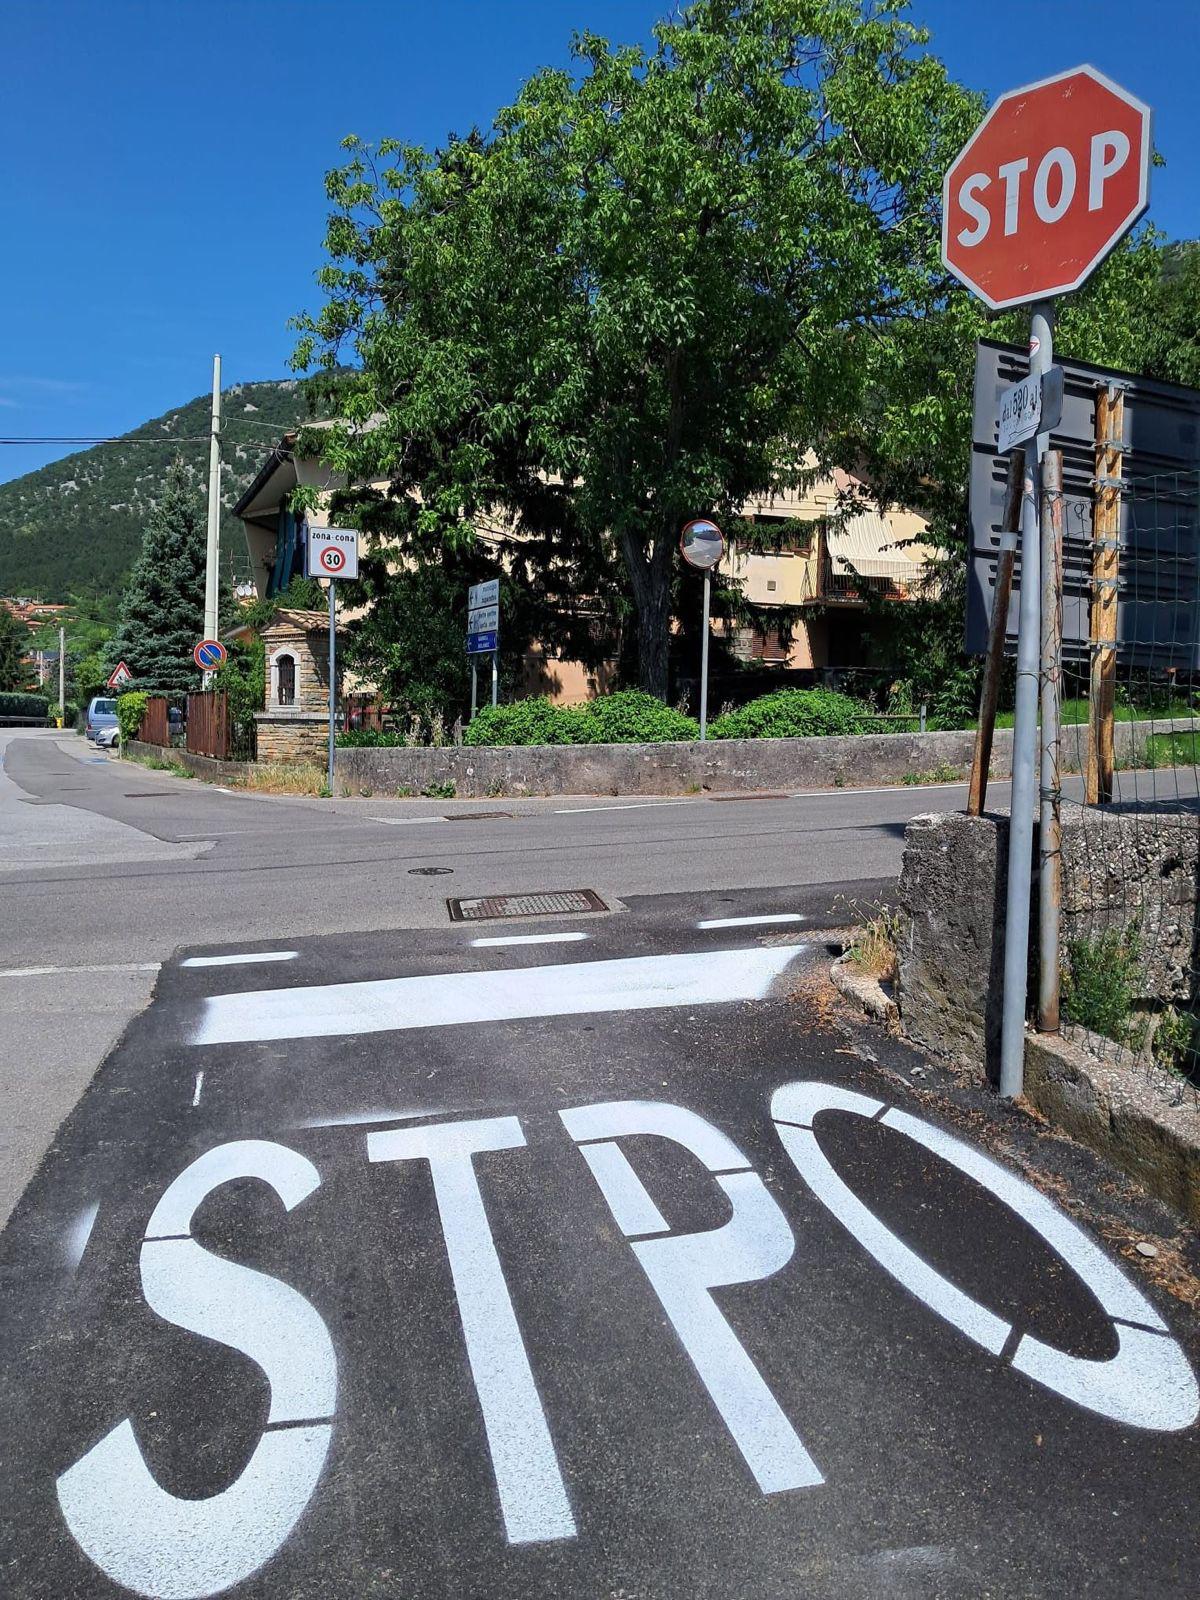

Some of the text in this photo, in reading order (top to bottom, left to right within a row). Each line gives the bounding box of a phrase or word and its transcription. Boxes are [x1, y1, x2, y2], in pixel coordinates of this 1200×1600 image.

[957, 130, 1131, 248] STOP
[1013, 385, 1028, 415] 520
[326, 554, 340, 565] 30
